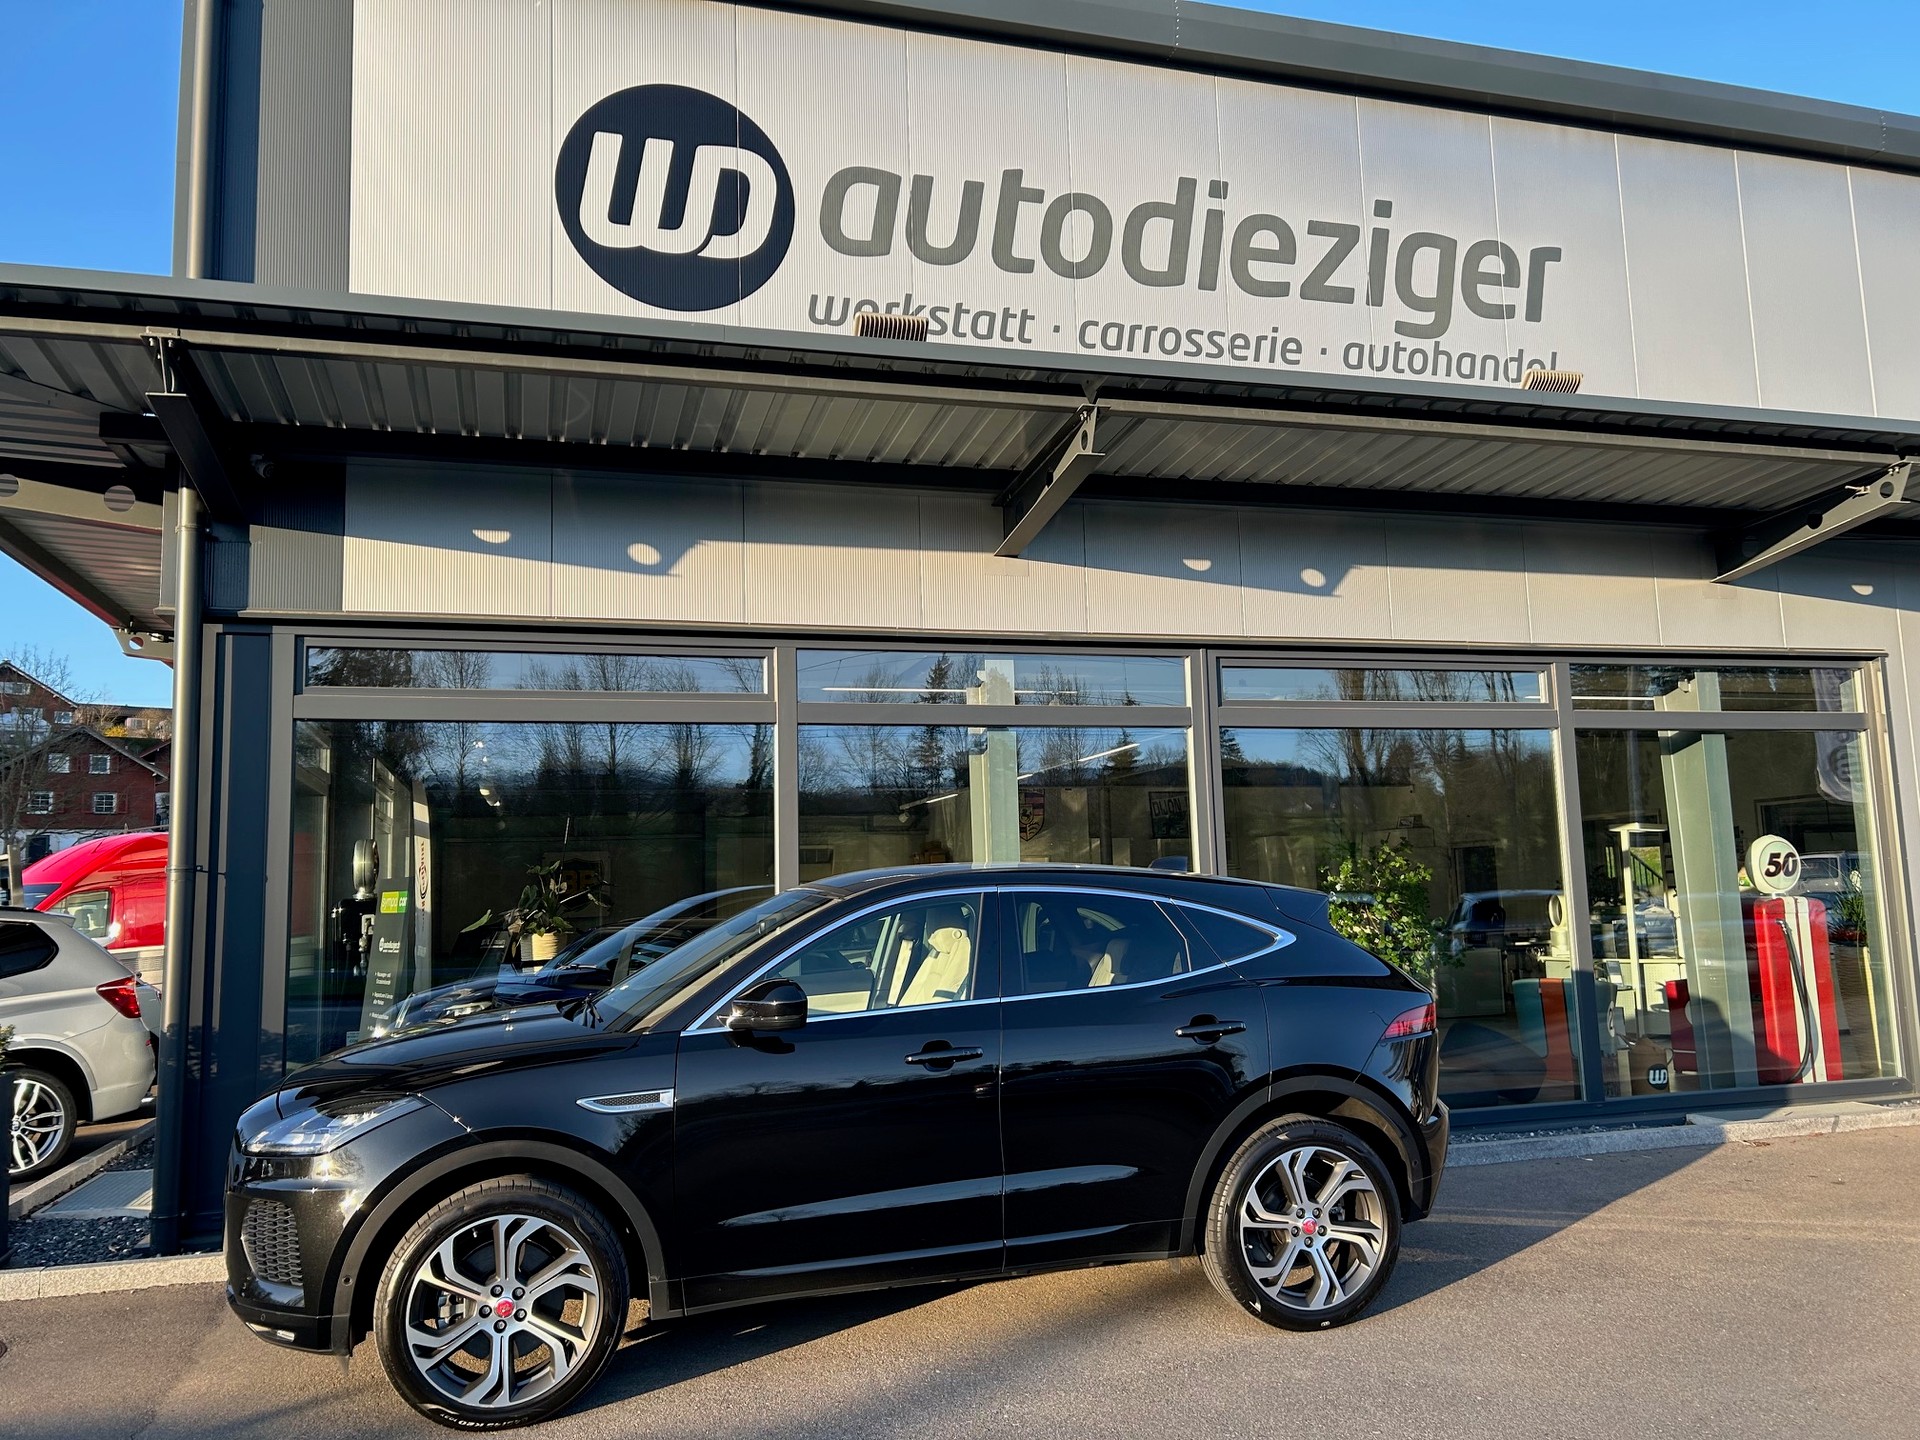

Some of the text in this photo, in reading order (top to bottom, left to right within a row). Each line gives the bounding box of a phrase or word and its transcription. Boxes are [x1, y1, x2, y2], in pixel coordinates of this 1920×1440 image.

[819, 165, 1562, 339] autodieziger
[1078, 319, 1303, 366] carrosserie
[1764, 851, 1798, 878] 50
